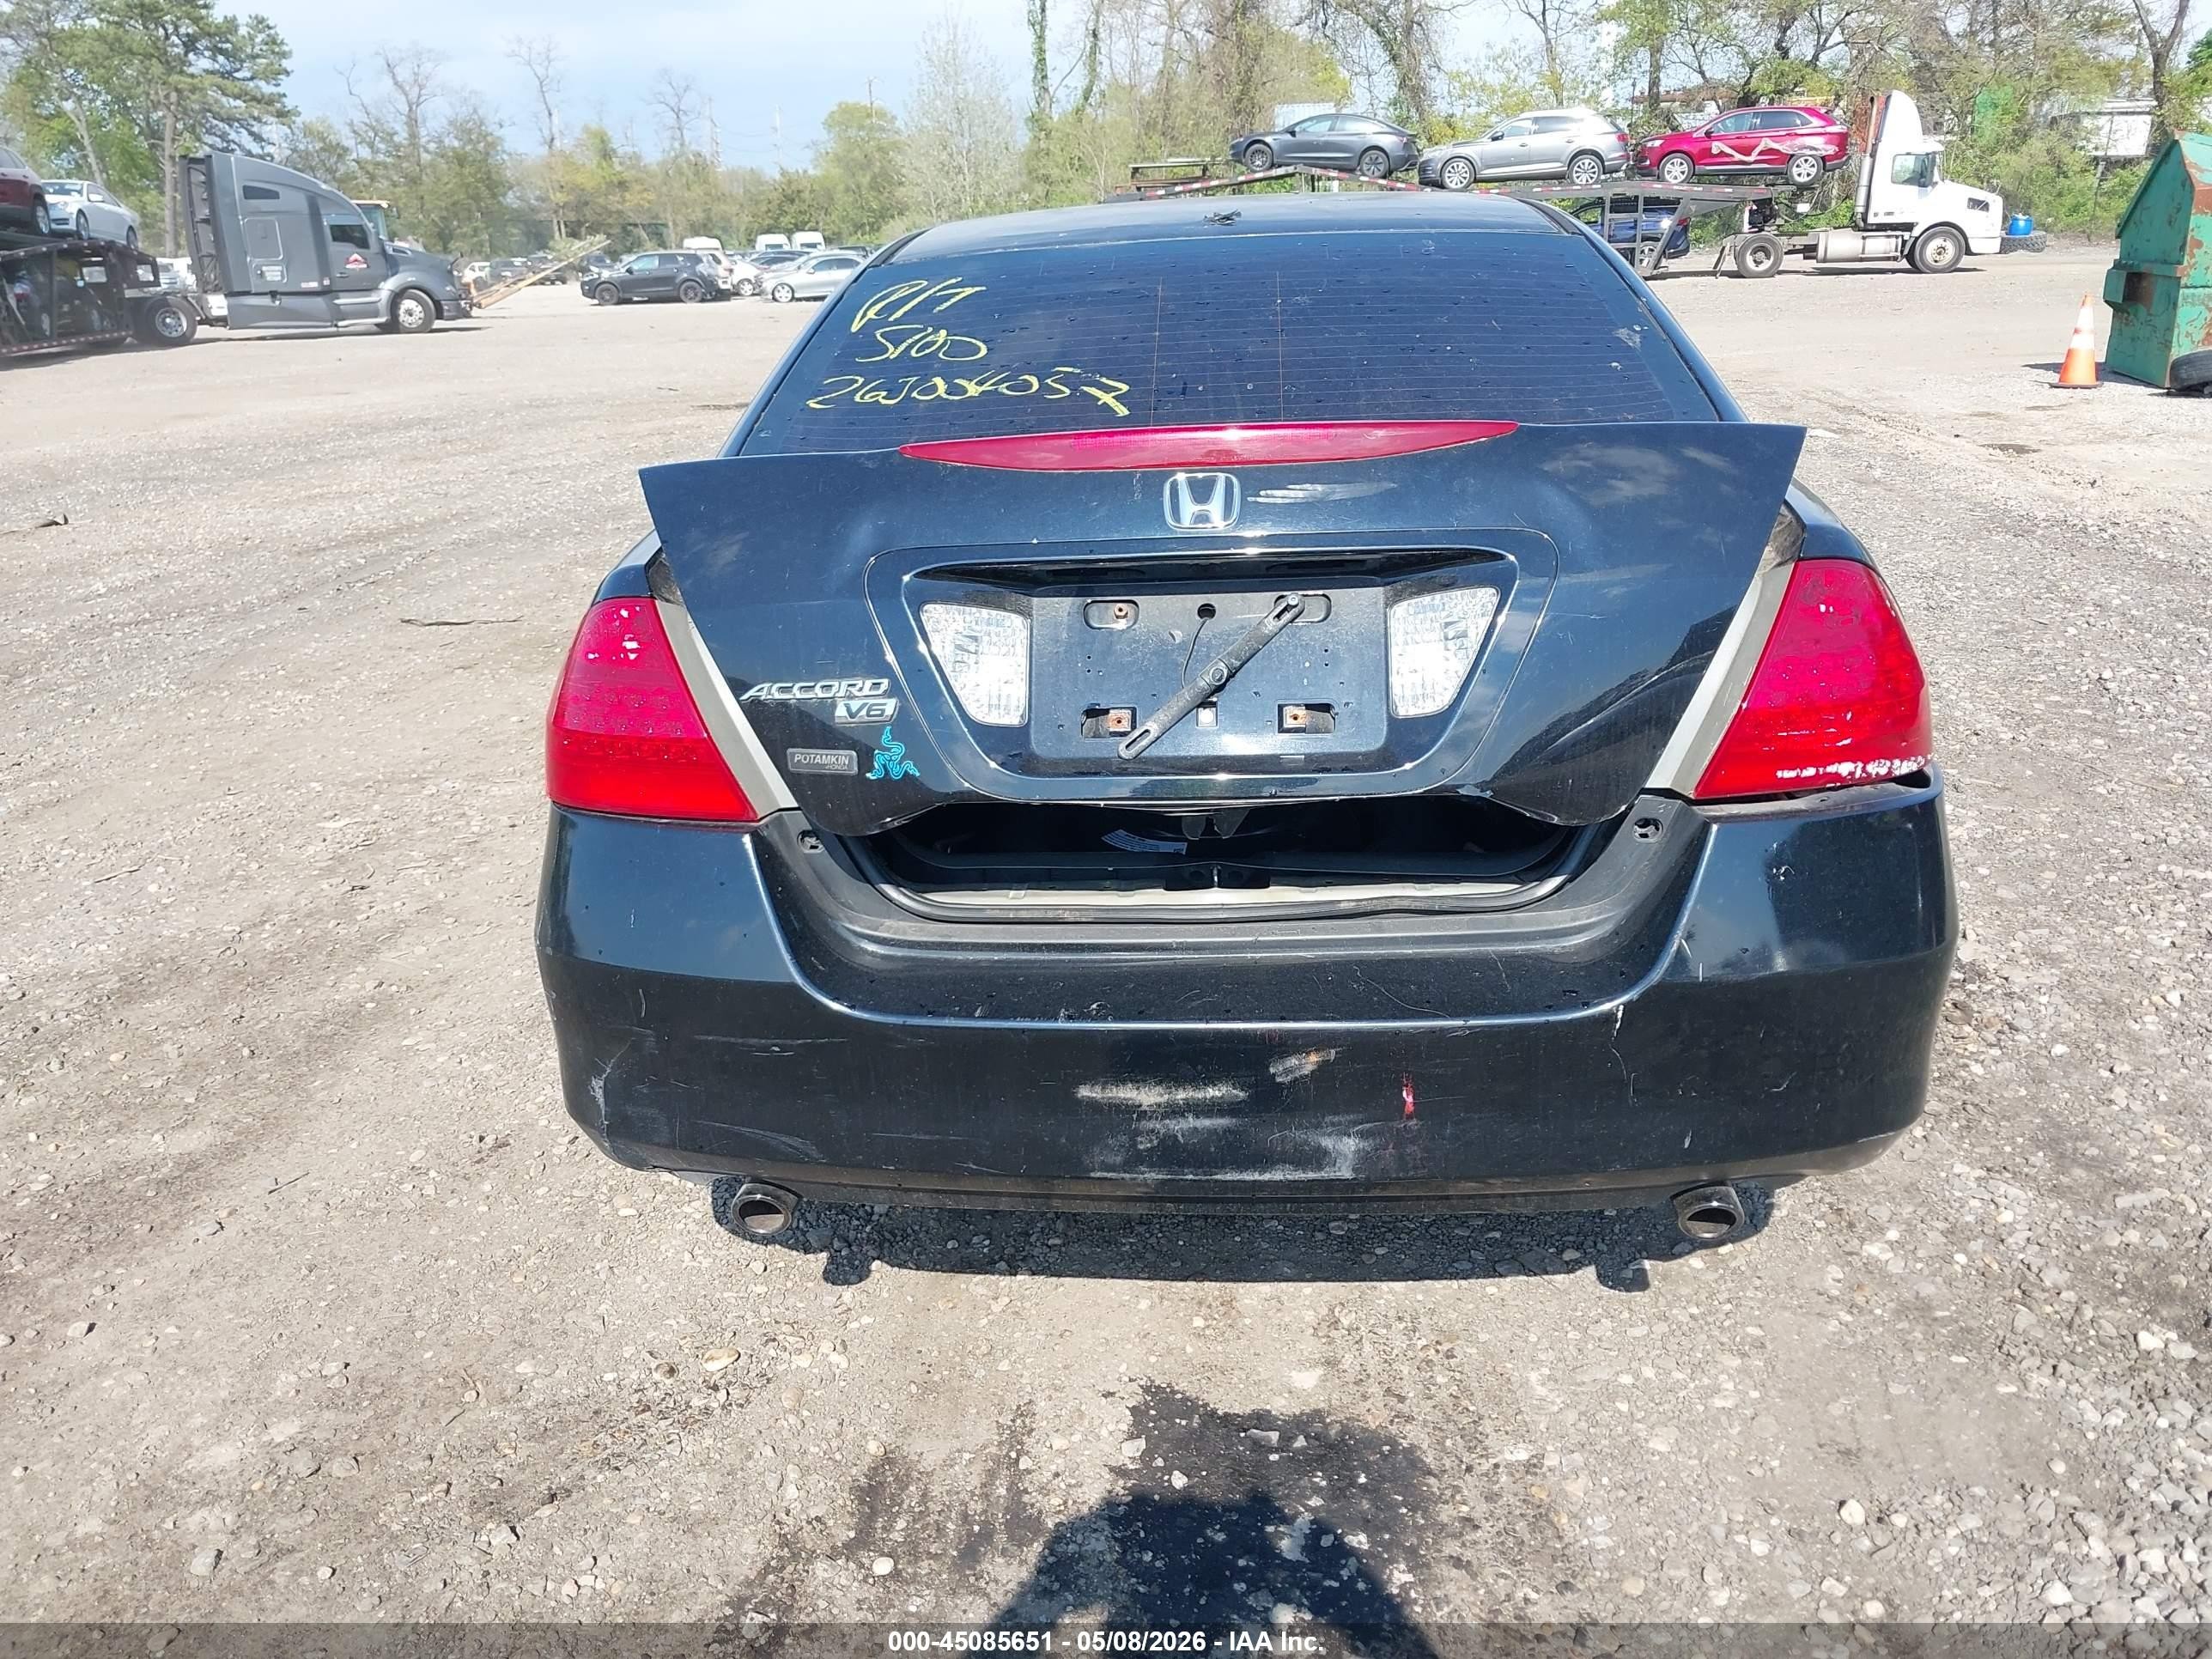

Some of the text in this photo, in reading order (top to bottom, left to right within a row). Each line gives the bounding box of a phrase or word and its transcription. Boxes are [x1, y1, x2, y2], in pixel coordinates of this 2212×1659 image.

[739, 678, 890, 702] ACCORD
[842, 702, 886, 720] V6
[794, 754, 849, 764] POTAMKIN
